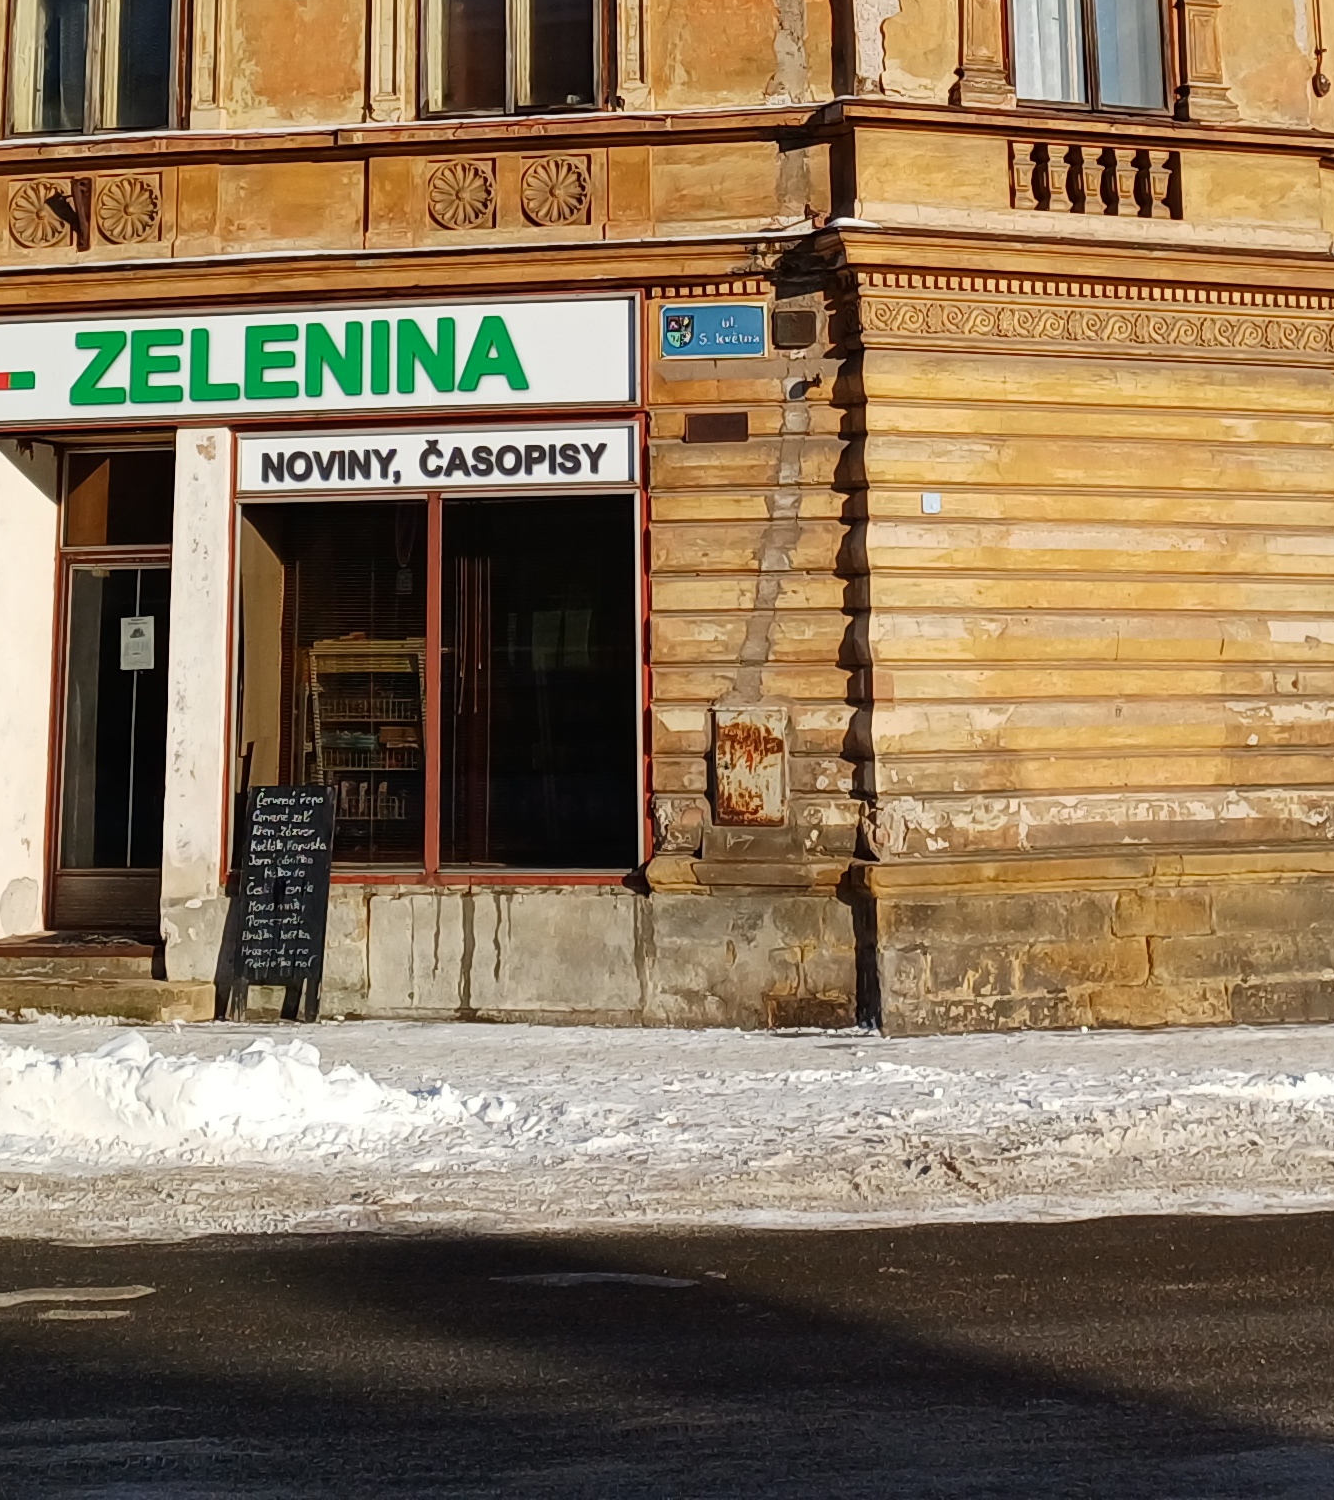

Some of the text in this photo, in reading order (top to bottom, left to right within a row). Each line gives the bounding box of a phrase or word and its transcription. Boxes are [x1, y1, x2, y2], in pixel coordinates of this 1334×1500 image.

[69, 315, 530, 405] ZELENINA
[715, 330, 761, 345] května
[261, 439, 608, 485] NOVINY, ČASOPISY
